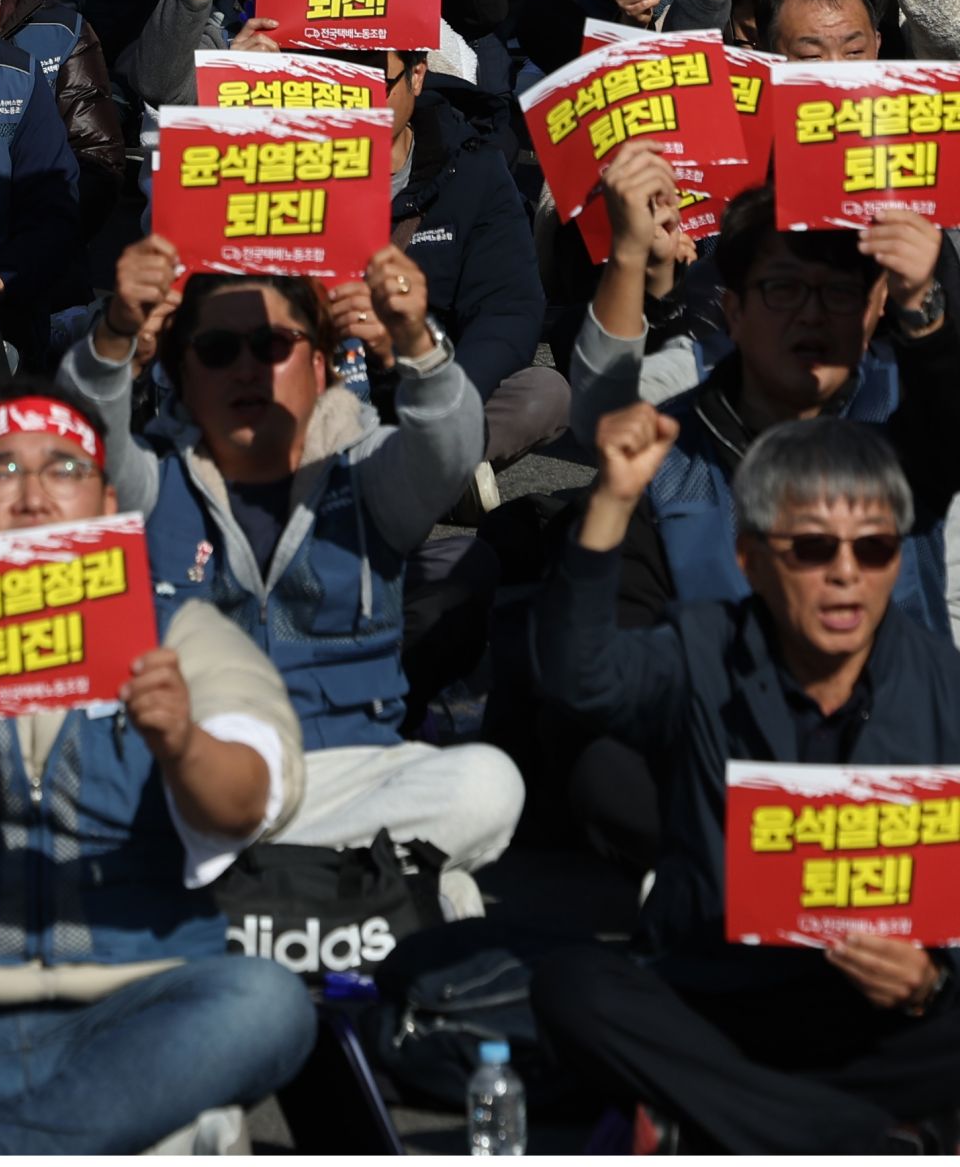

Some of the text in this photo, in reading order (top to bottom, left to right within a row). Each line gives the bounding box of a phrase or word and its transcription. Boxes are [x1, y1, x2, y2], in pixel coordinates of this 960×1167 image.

[321, 29, 386, 39] 전국택배노동조합
[545, 52, 710, 144] 윤석열정권
[588, 95, 677, 159] 퇴진!
[180, 138, 371, 187] 윤석열정권
[842, 142, 938, 192] 퇴진!
[223, 189, 326, 237] 퇴진!
[750, 798, 960, 852] 윤석열정권
[800, 854, 913, 907] 퇴진!
